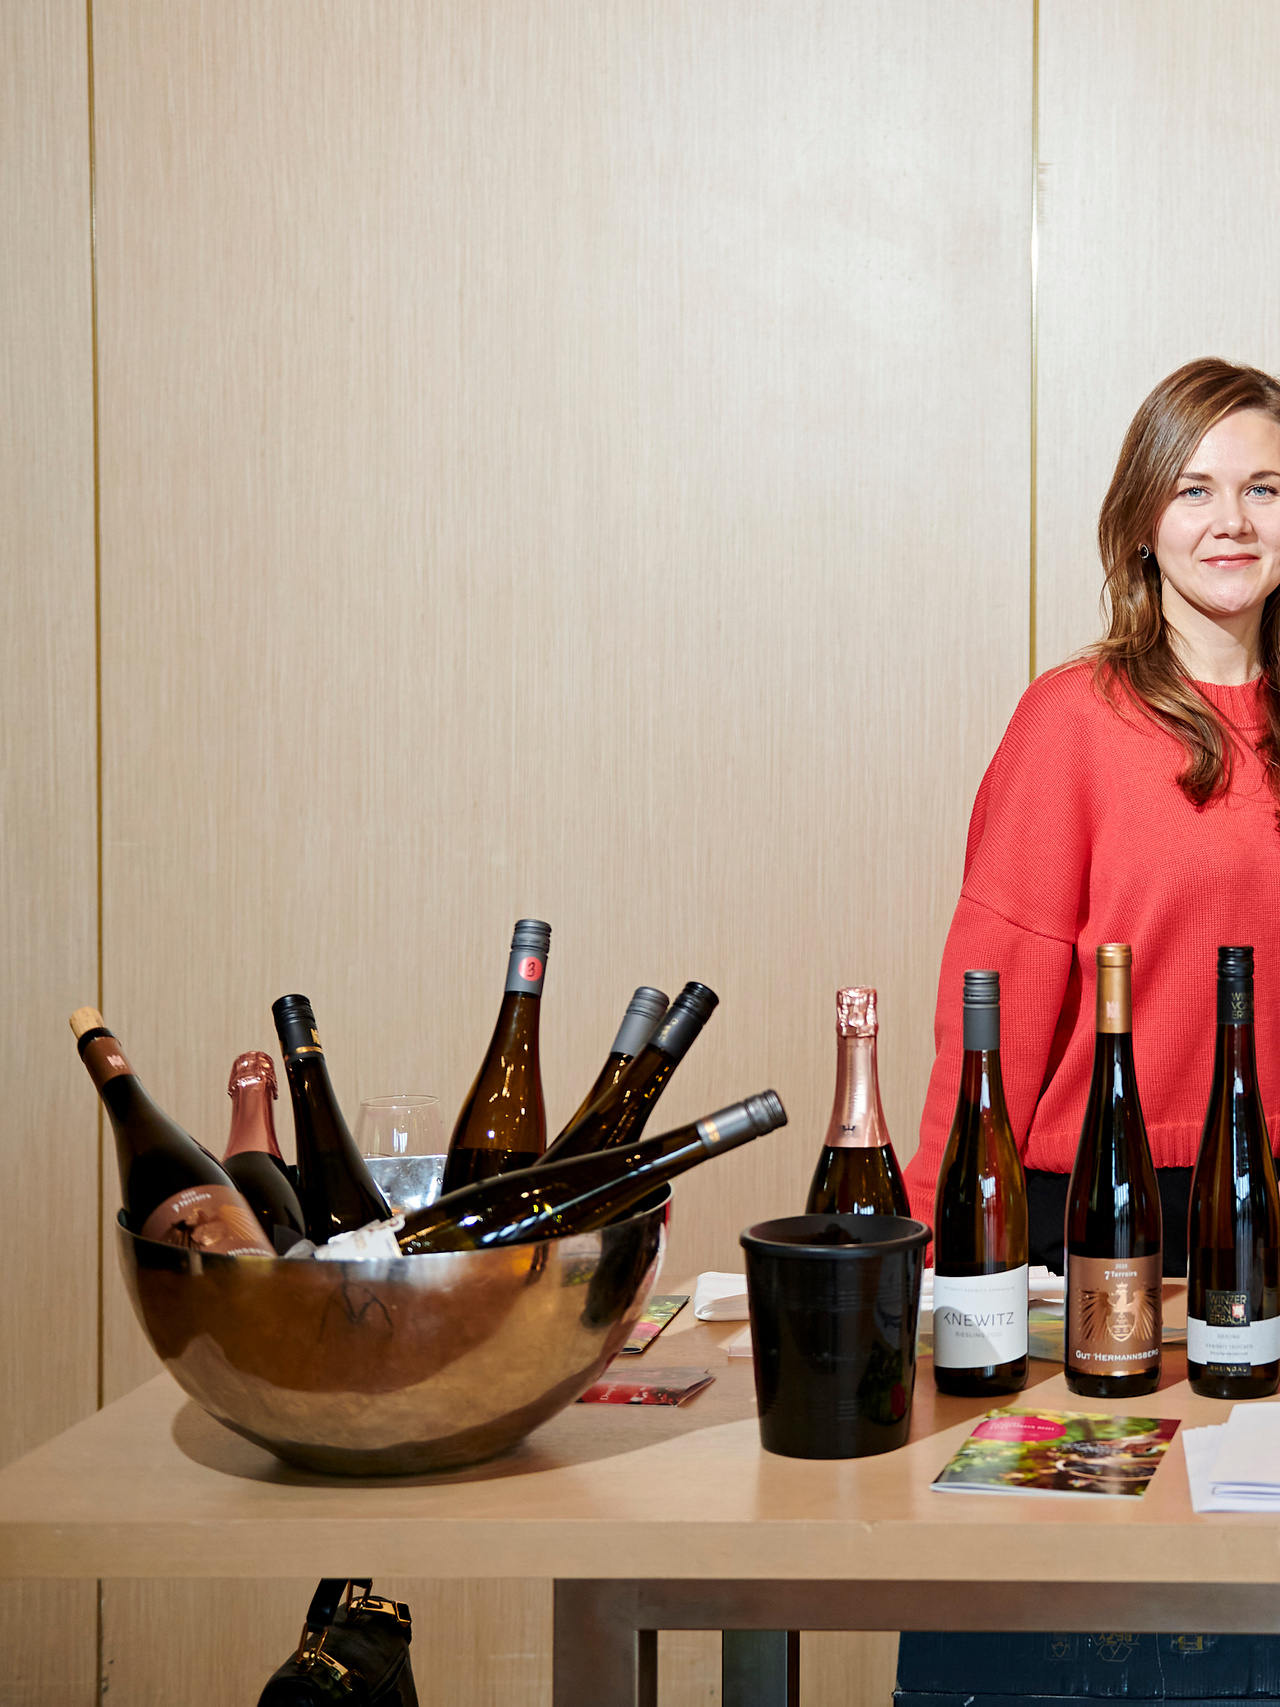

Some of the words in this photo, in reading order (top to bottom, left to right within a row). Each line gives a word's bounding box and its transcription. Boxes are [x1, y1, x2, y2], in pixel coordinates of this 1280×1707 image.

[527, 961, 536, 978] 3
[1104, 1271, 1110, 1281] 7
[1209, 1294, 1248, 1305] WINZER
[1209, 1304, 1232, 1315] VON
[1209, 1313, 1247, 1325] ERBACH
